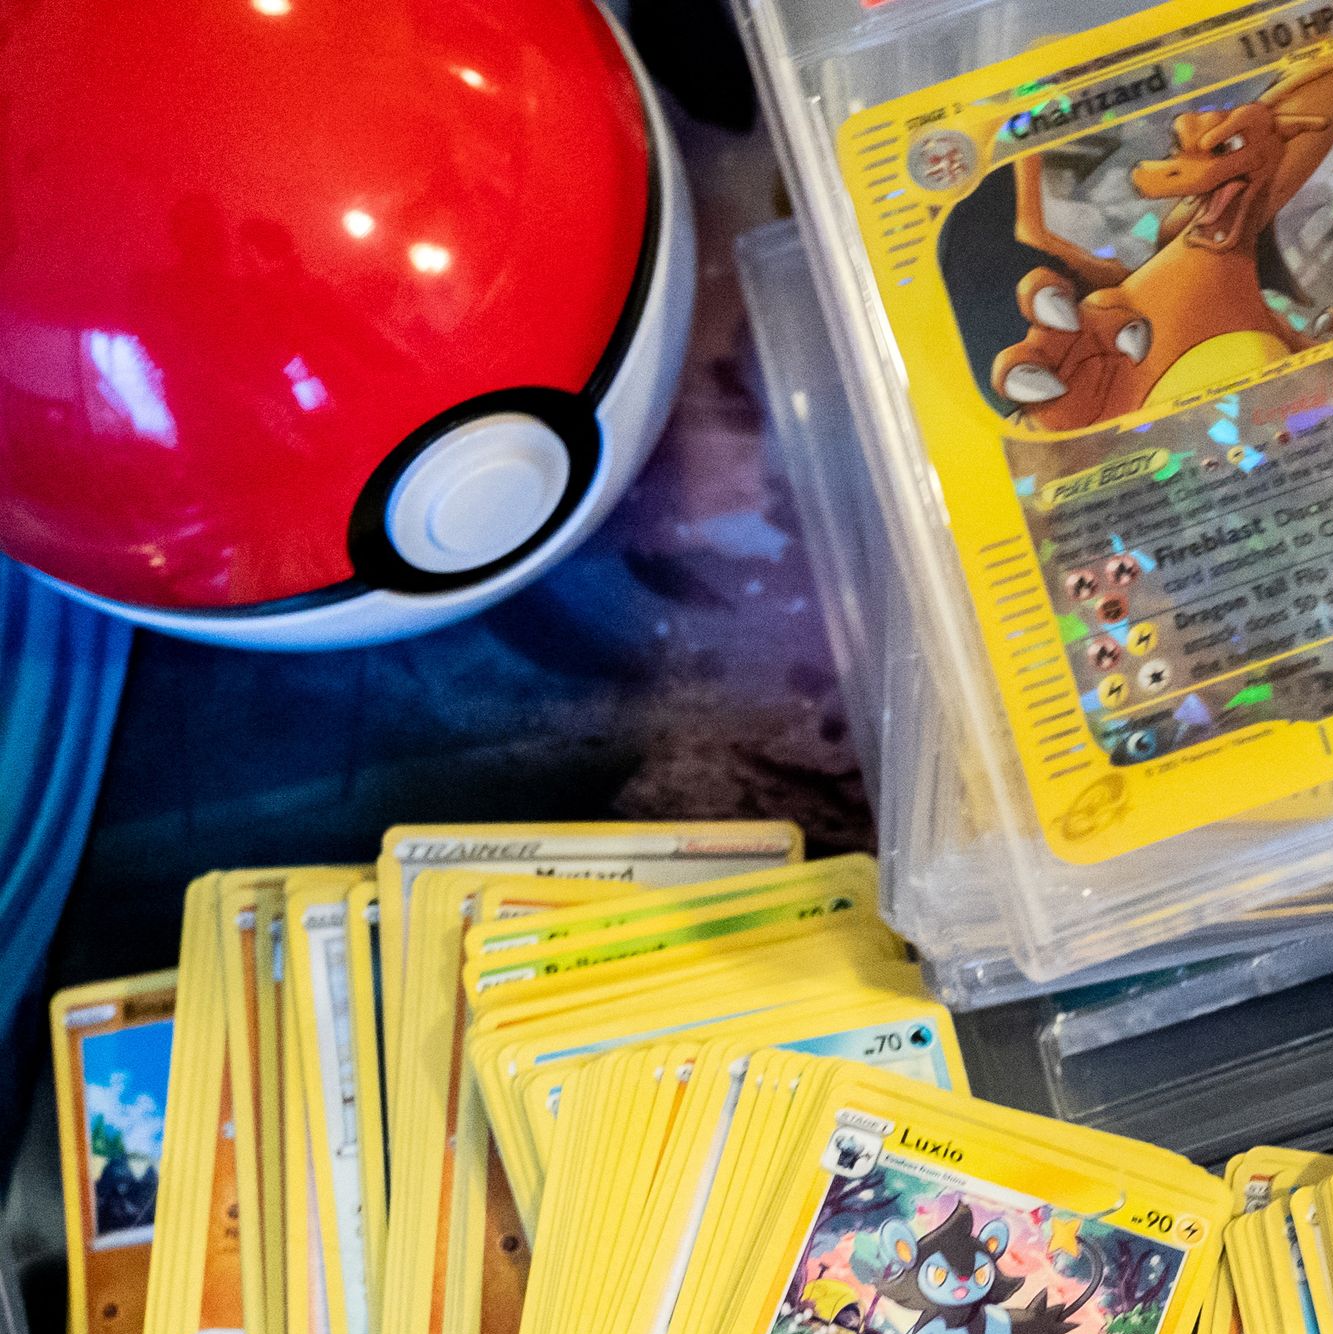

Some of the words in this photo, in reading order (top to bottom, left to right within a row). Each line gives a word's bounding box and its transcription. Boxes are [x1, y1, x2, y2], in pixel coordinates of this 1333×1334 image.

[1238, 23, 1294, 60] 110
[1007, 65, 1172, 140] Charizard
[406, 839, 543, 859] TRAINER
[874, 1033, 902, 1052] 70
[900, 1126, 964, 1163] Luxio
[1146, 1209, 1173, 1235] 90
